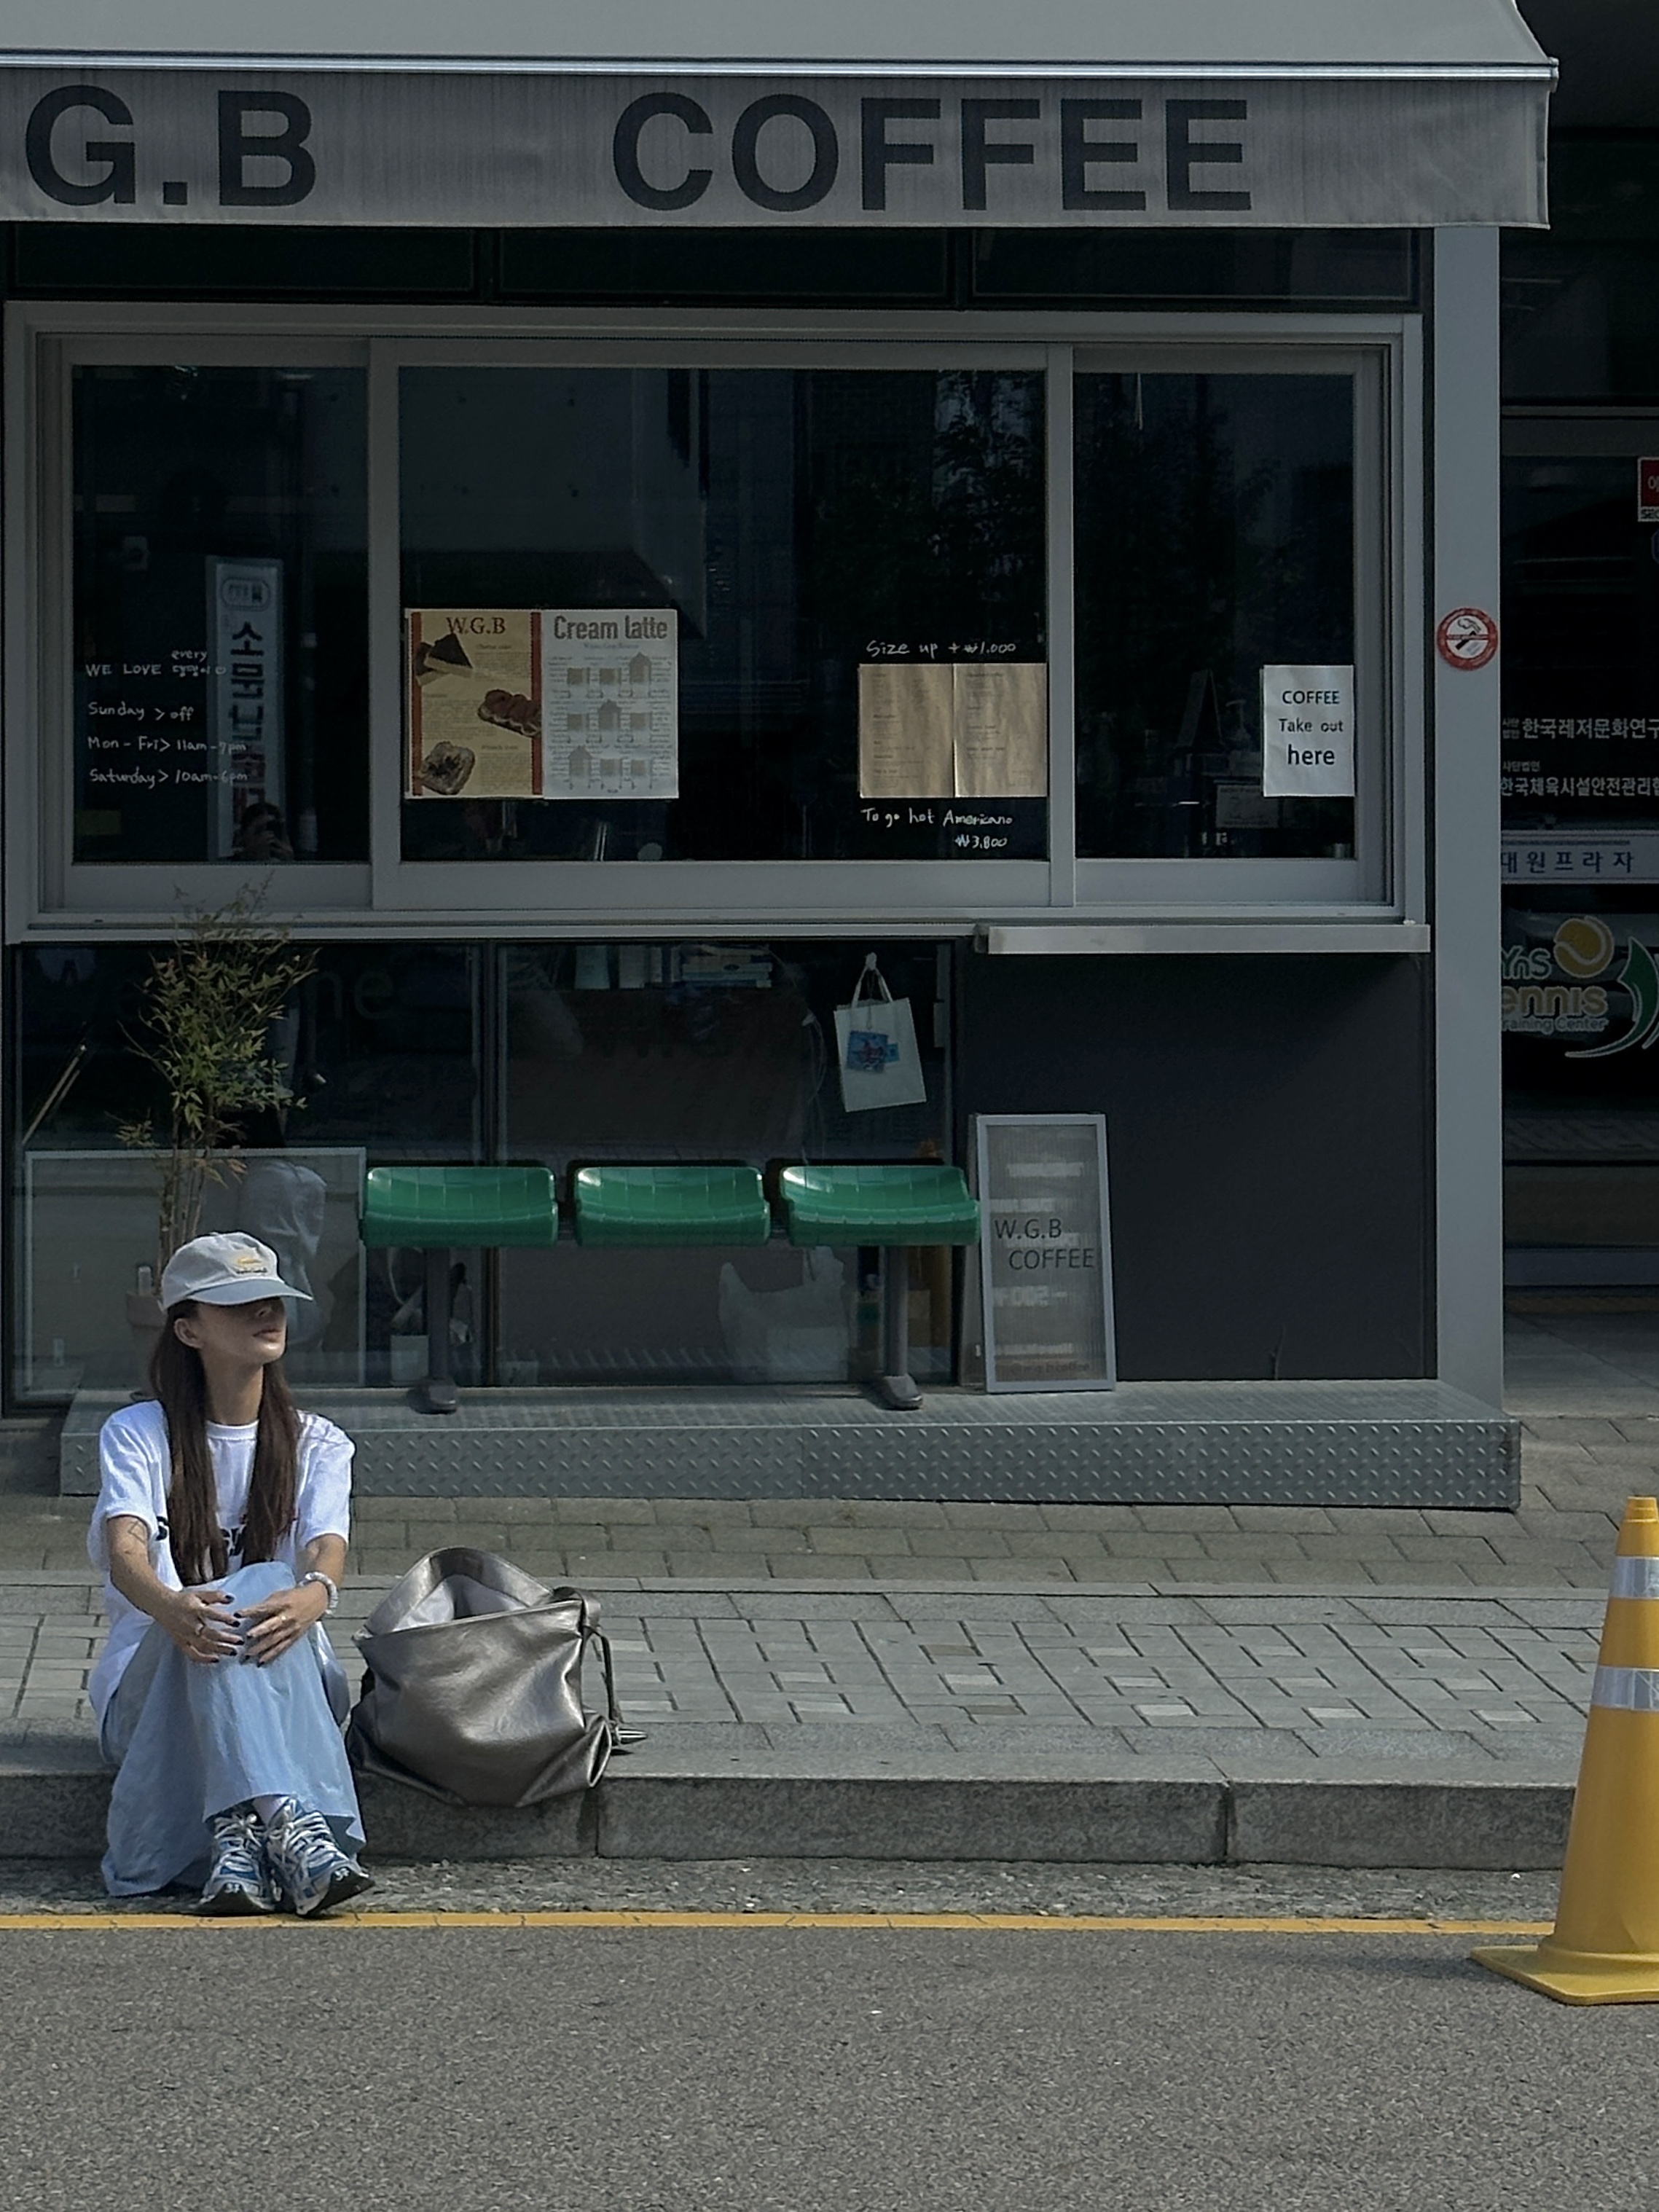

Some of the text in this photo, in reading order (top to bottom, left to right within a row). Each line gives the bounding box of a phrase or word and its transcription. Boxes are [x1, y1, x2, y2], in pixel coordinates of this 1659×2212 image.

[613, 92, 1253, 212] COFFEE
[447, 616, 506, 635] W.G.B
[554, 615, 668, 640] Cream latte
[170, 649, 208, 662] every
[866, 640, 911, 657] Size
[919, 641, 938, 659] up
[85, 664, 112, 677] WE
[123, 664, 162, 676] LOVE
[1282, 690, 1341, 705] COFFEE
[88, 701, 145, 721] Sunday
[170, 705, 195, 722] off
[1279, 718, 1344, 733] Take out
[87, 735, 119, 750] Mon
[1287, 744, 1336, 765] here
[860, 808, 879, 821] To
[909, 807, 935, 825] hot
[942, 809, 1013, 828] Americano
[1556, 1018, 1607, 1031] Center
[995, 1218, 1062, 1239] W.G.B
[1009, 1248, 1094, 1270] COFFEE
